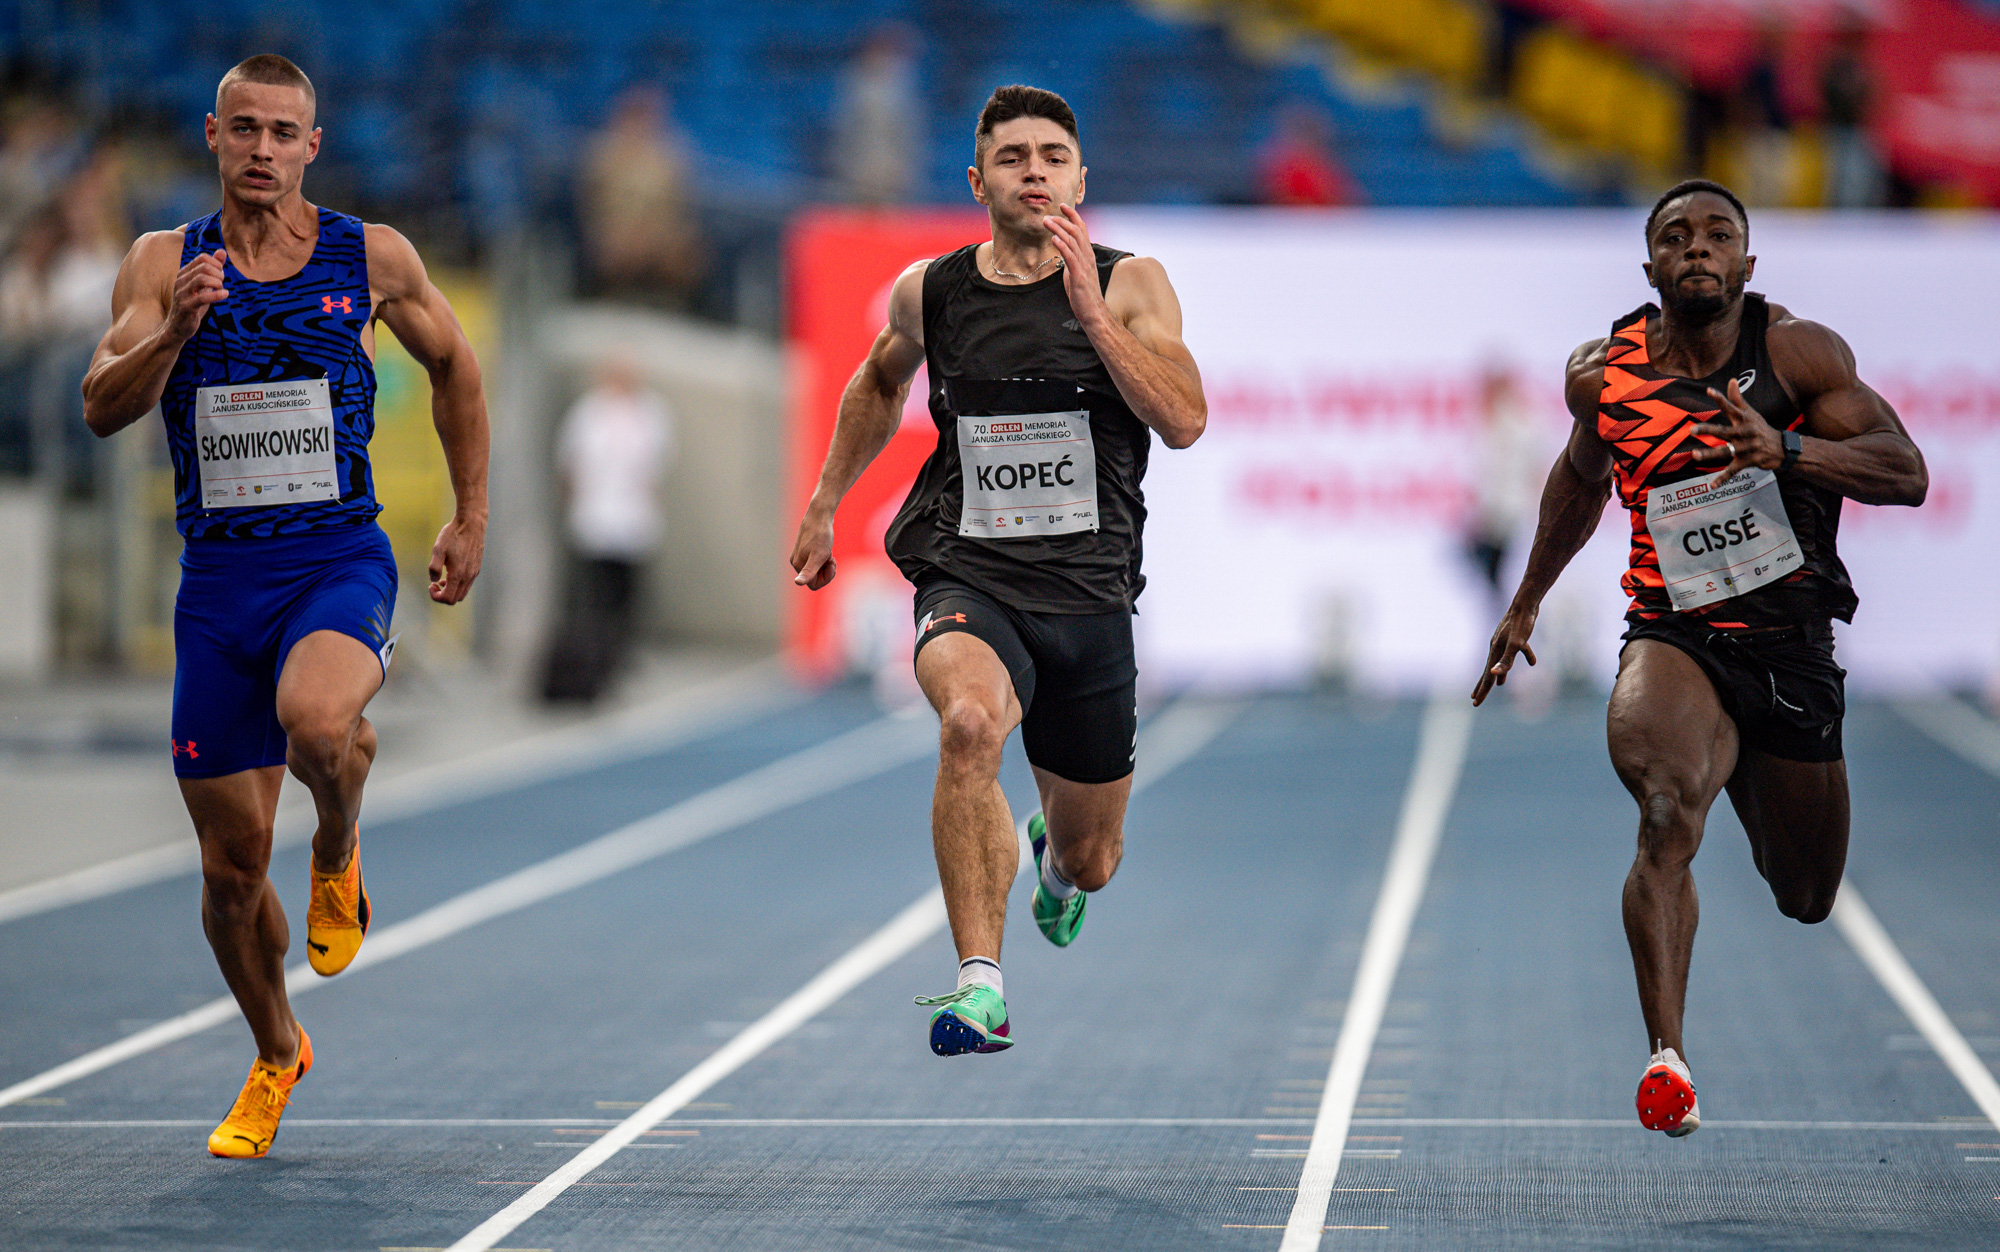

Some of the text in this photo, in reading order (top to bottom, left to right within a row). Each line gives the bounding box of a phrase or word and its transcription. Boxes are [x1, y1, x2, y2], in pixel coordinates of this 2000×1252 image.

[212, 398, 311, 413] JANUSZA KUSOCIŃSKIEGO
[214, 389, 307, 404] 70. ORLEN MEMORIAŁ
[974, 420, 1067, 434] 70. ORLEN MEMORIAŁ
[202, 426, 329, 462] SŁOWIKOWSKI
[972, 430, 1071, 444] JANUSZA KUSOCIŃSKIEGO
[976, 454, 1074, 490] KOPEĆ
[1660, 493, 1676, 504] 70.
[1678, 485, 1707, 498] ORLEN
[1662, 481, 1756, 514] JANUSZA KUSOCIŃSKIEGO
[1682, 506, 1760, 556] CISSÉ
